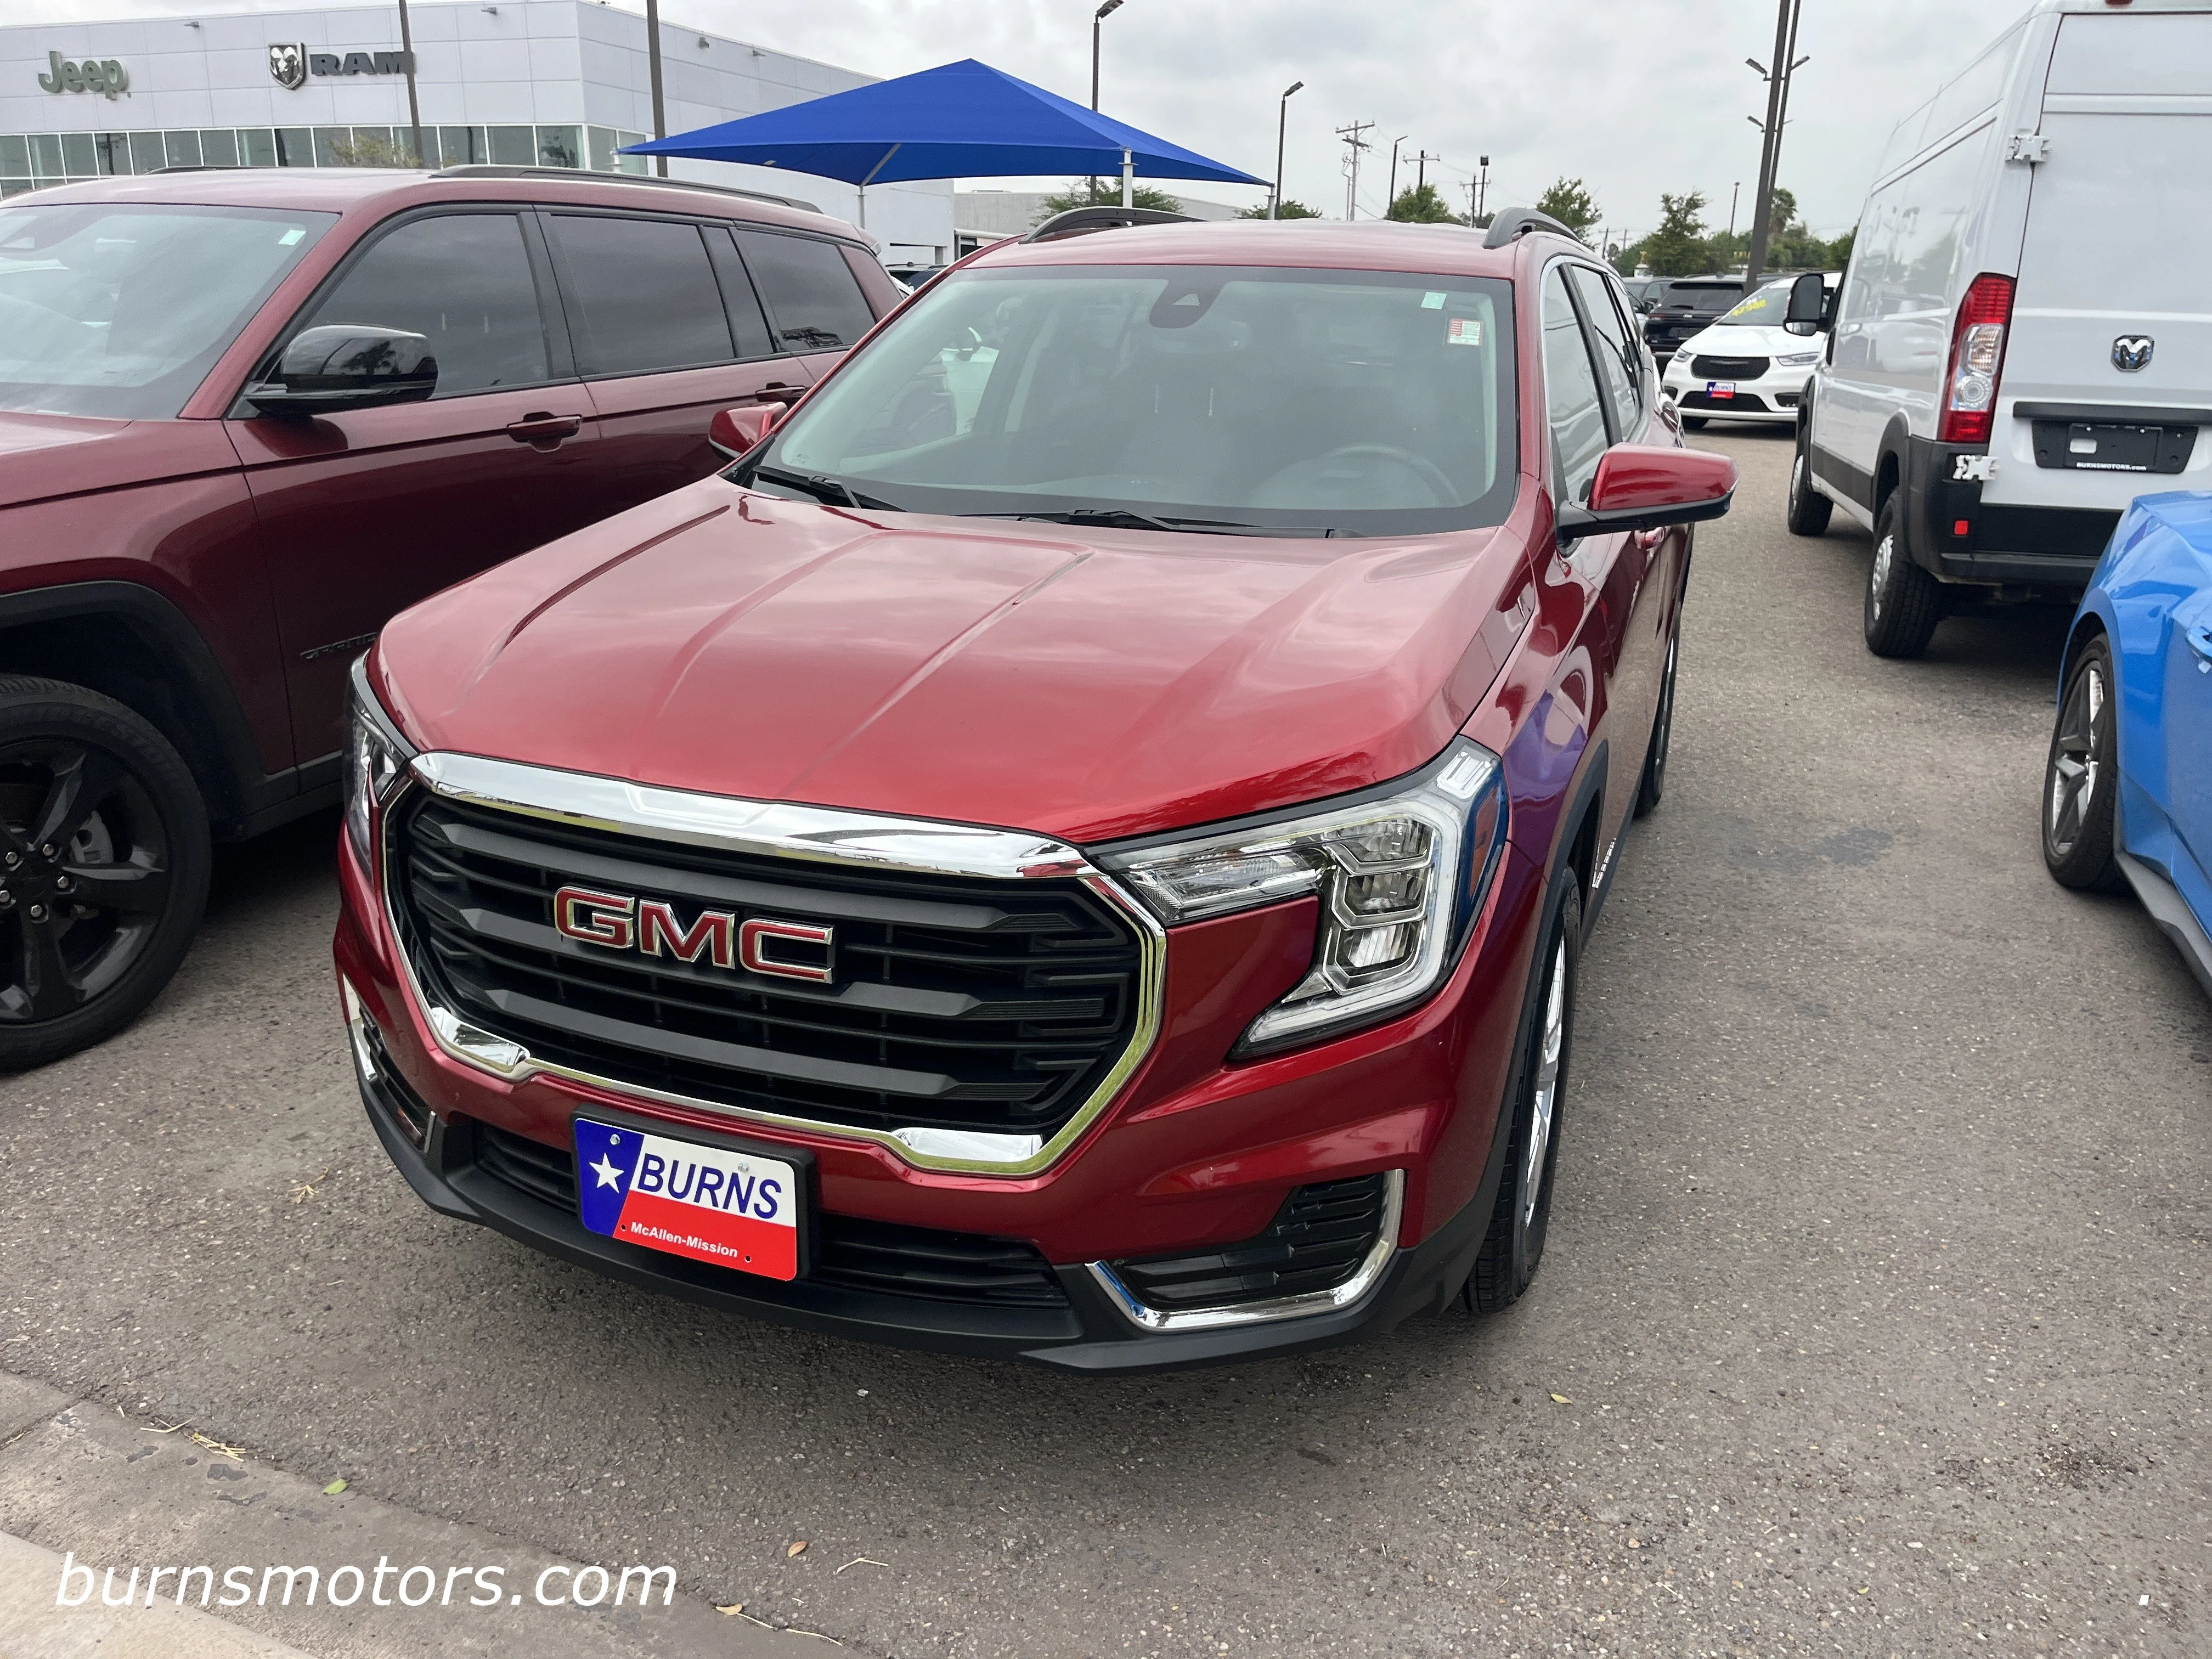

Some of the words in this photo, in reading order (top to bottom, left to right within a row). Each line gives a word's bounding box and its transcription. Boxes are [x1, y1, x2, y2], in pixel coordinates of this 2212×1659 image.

[38, 51, 127, 100] Jeep
[309, 51, 415, 76] RAM
[554, 885, 833, 984] GMC
[637, 1153, 782, 1218] BURNS
[630, 1221, 738, 1258] McAllen-Mission
